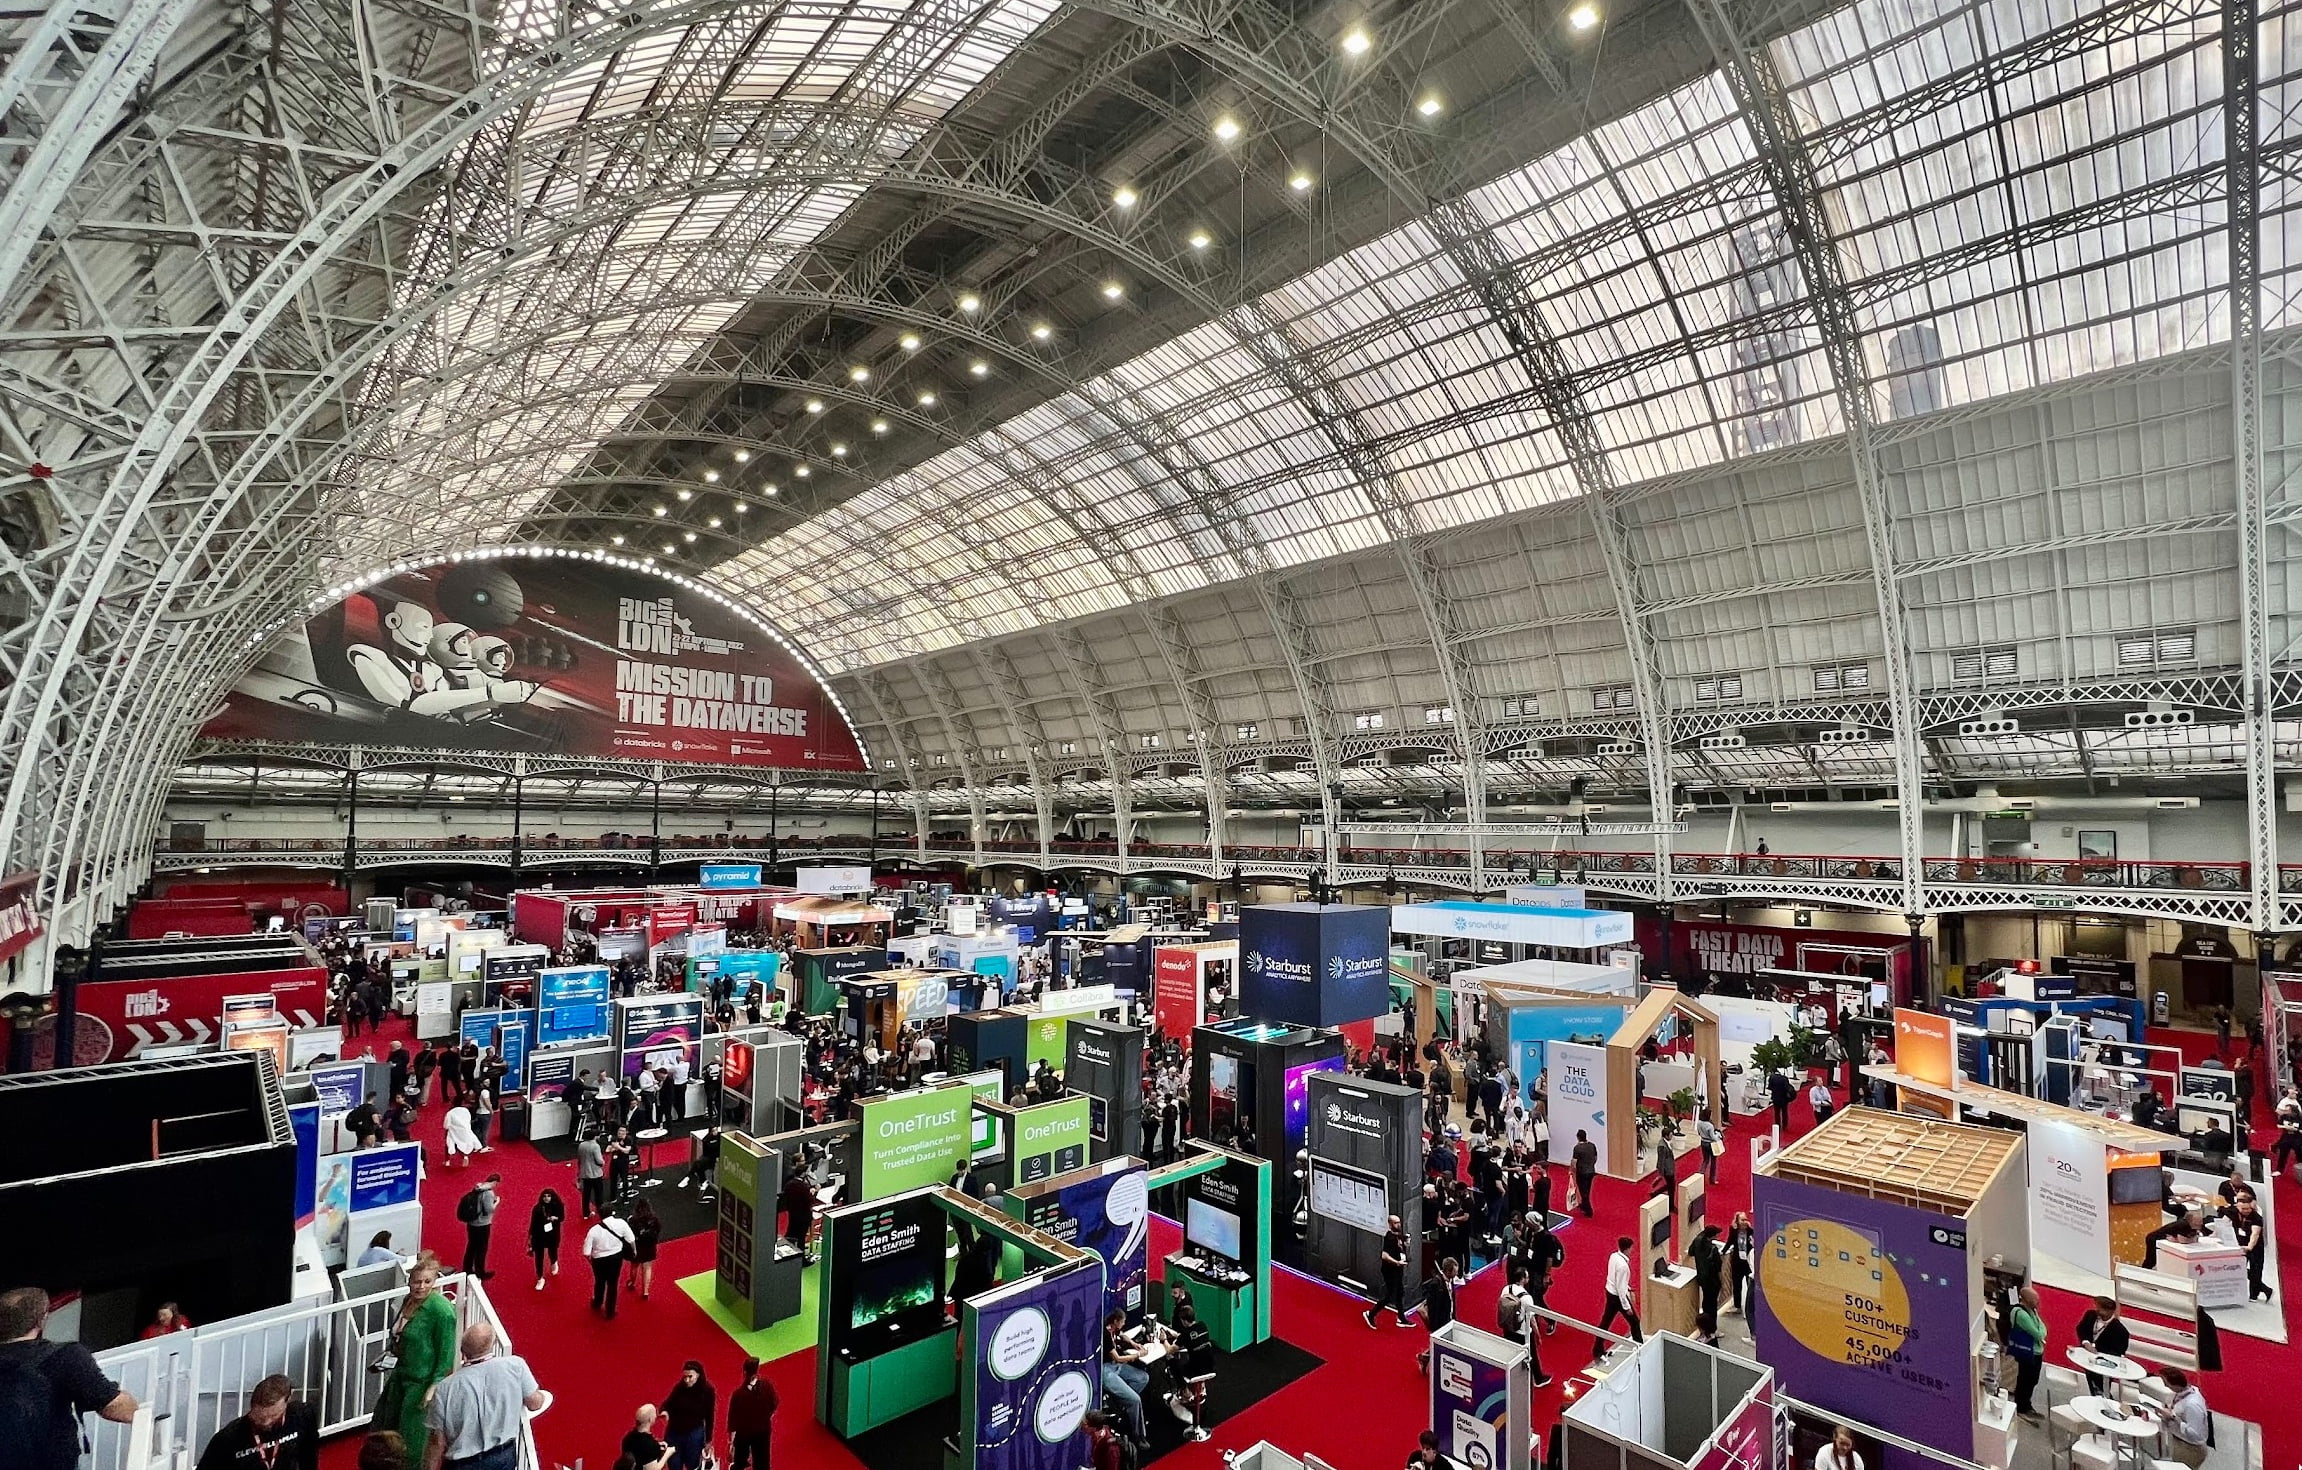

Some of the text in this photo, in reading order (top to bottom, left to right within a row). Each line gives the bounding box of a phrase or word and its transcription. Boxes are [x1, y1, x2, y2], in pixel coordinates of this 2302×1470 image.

[619, 597, 657, 625] BIG
[616, 660, 773, 705] MISSION TO
[615, 692, 807, 737] THE DATAVERSE
[623, 739, 666, 749] databricks
[713, 871, 750, 882] pyramid
[1468, 918, 1508, 930] snowflake
[1690, 930, 1784, 956] FAST DATA
[1161, 960, 1186, 971] denodo
[1265, 957, 1312, 975] Starburst
[1346, 956, 1382, 972] Starburst
[1699, 950, 1776, 973] THEATRE
[897, 982, 948, 1012] SPEED
[1087, 1045, 1110, 1058] Starburst
[317, 1072, 357, 1082] touchstone
[1566, 1065, 1587, 1077] THE
[1559, 1083, 1595, 1097] CLOUD
[1564, 1075, 1591, 1088] DATA
[879, 1108, 957, 1138] OneTrust
[1024, 1116, 1081, 1141] OneTrust
[1343, 1110, 1380, 1129] Starburst
[874, 1132, 962, 1160] Turn Compliance Into
[883, 1147, 953, 1171] Trusted Data Use
[356, 1169, 369, 1177] For
[723, 1155, 753, 1188] OneTrust
[1201, 1174, 1239, 1195] Eden Smith
[1054, 1217, 1078, 1232] Smith
[861, 1223, 920, 1250] Eden Smith
[861, 1236, 915, 1258] DATA STAFFING
[1844, 1294, 1884, 1314] 500+
[1006, 1326, 1033, 1343] Build high
[1844, 1310, 1920, 1340] CUSTOMERS
[1003, 1336, 1035, 1353] performing
[1846, 1336, 1913, 1365] 45,000+
[1846, 1351, 1893, 1375] ACTIVE
[1456, 1415, 1472, 1427] Data
[1456, 1422, 1480, 1439] Quality
